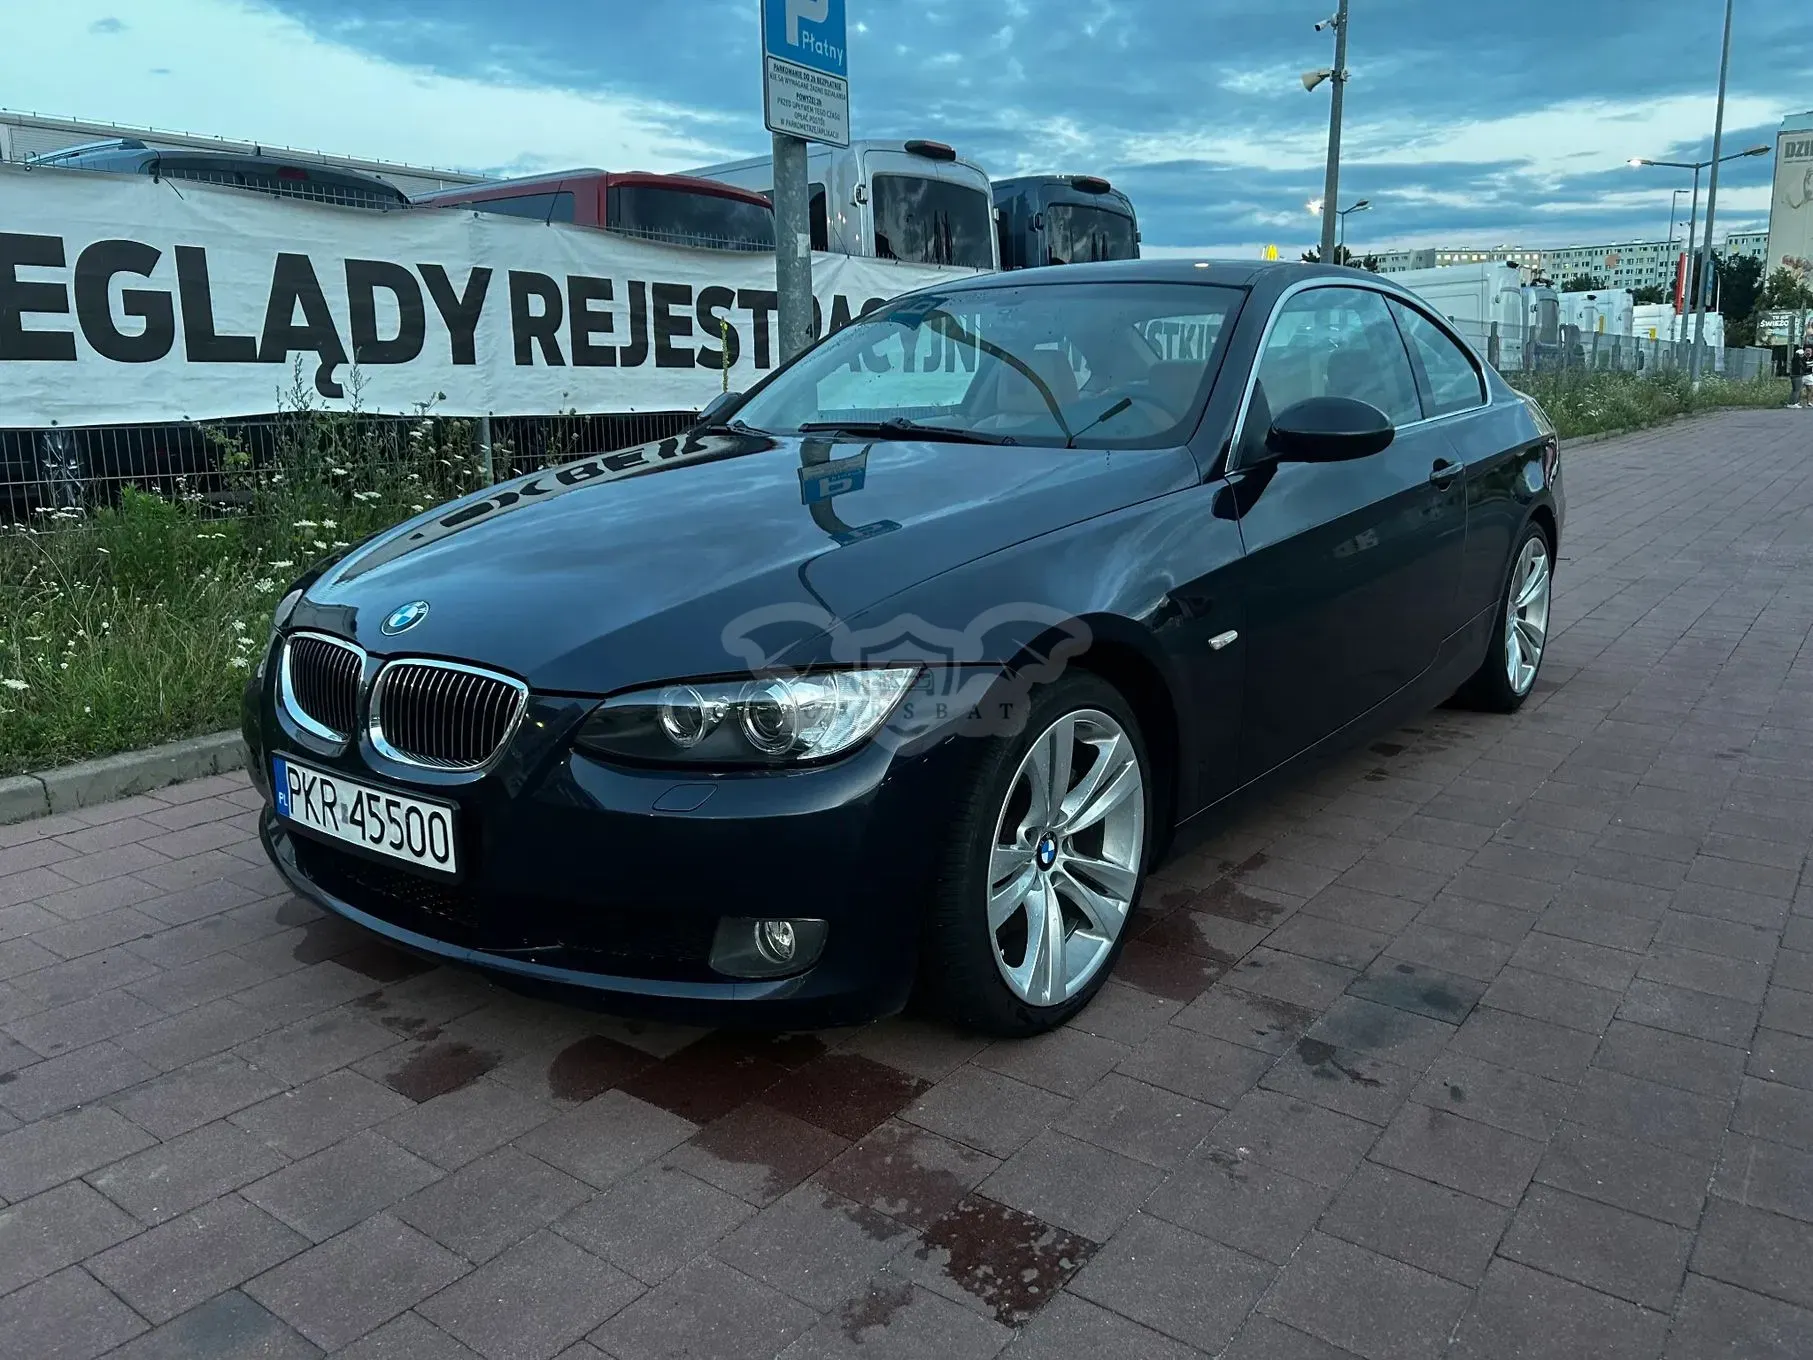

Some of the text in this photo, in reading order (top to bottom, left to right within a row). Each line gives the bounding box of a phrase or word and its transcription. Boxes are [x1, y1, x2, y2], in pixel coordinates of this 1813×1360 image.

[803, 30, 843, 66] Płatny
[1784, 140, 1813, 158] DZI
[278, 793, 288, 807] PL
[287, 767, 449, 864] PKR 45500
